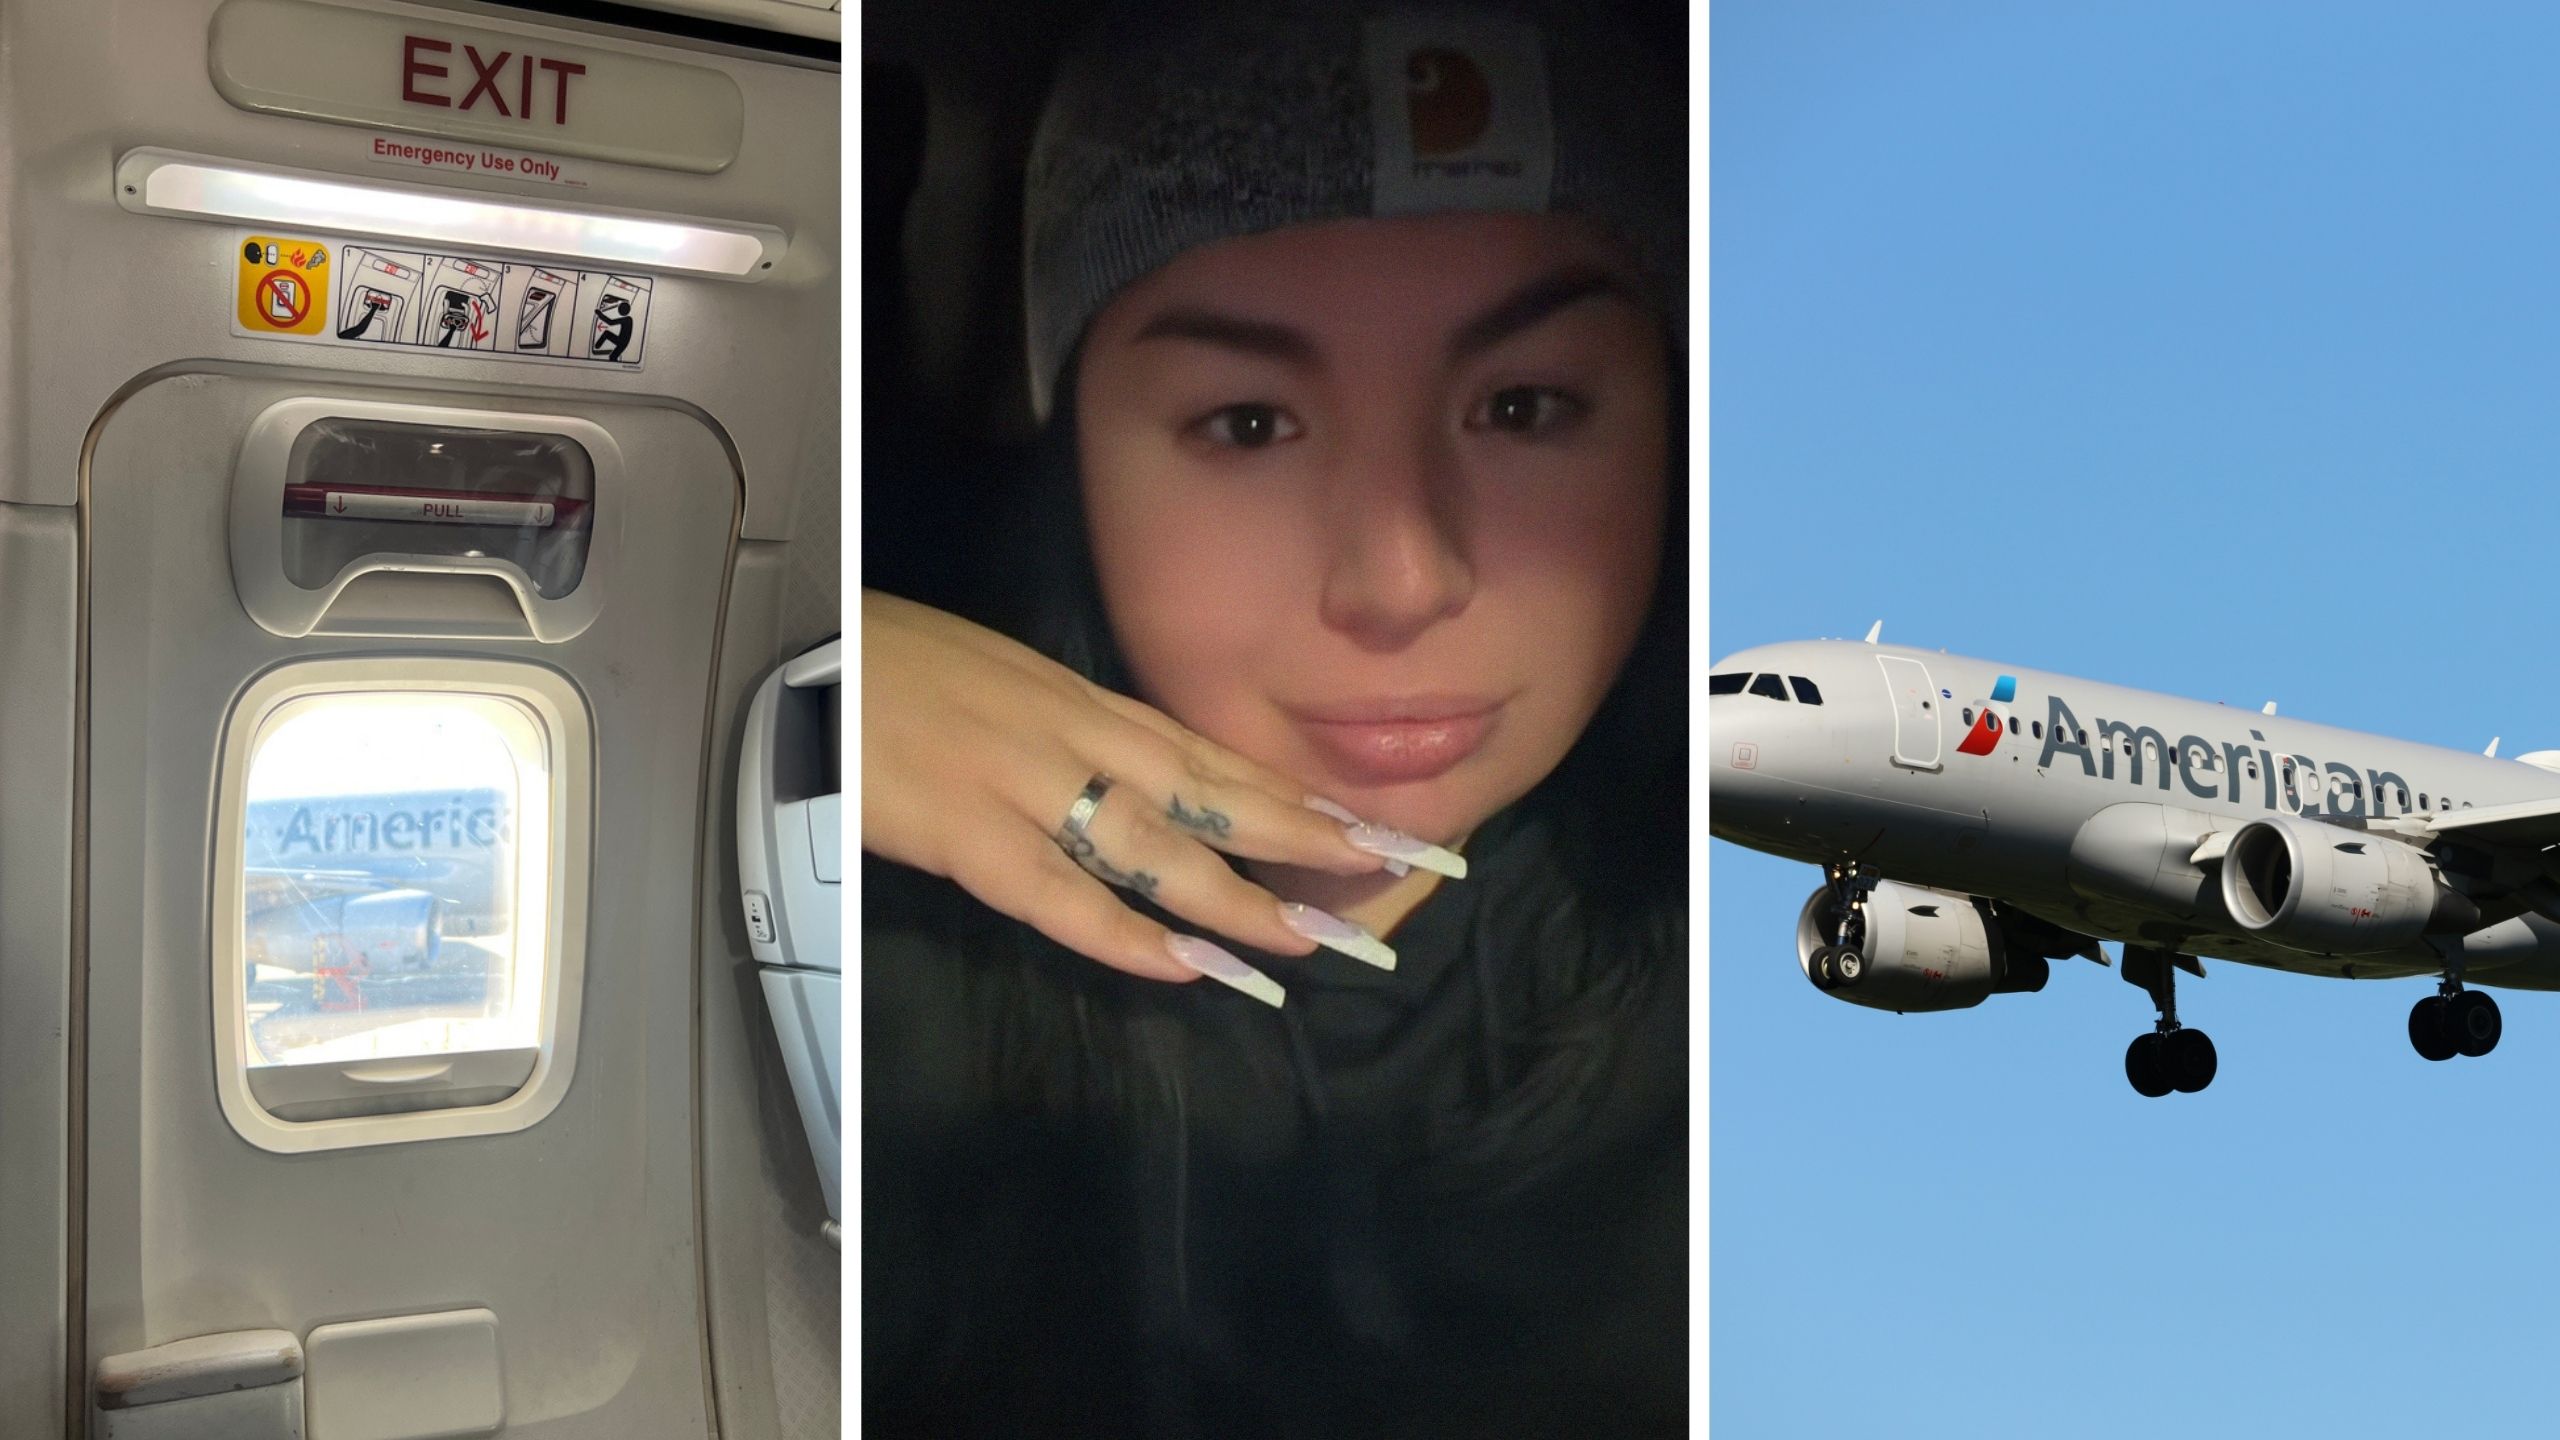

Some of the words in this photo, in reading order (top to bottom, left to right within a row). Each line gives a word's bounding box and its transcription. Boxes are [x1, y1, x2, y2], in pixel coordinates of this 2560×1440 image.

[402, 35, 587, 125] EXIT
[374, 138, 475, 170] Emergency
[481, 152, 514, 172] Use
[520, 157, 560, 181] Only
[423, 503, 464, 518] PULL
[2038, 695, 2413, 817] American
[280, 796, 511, 854] Americ
